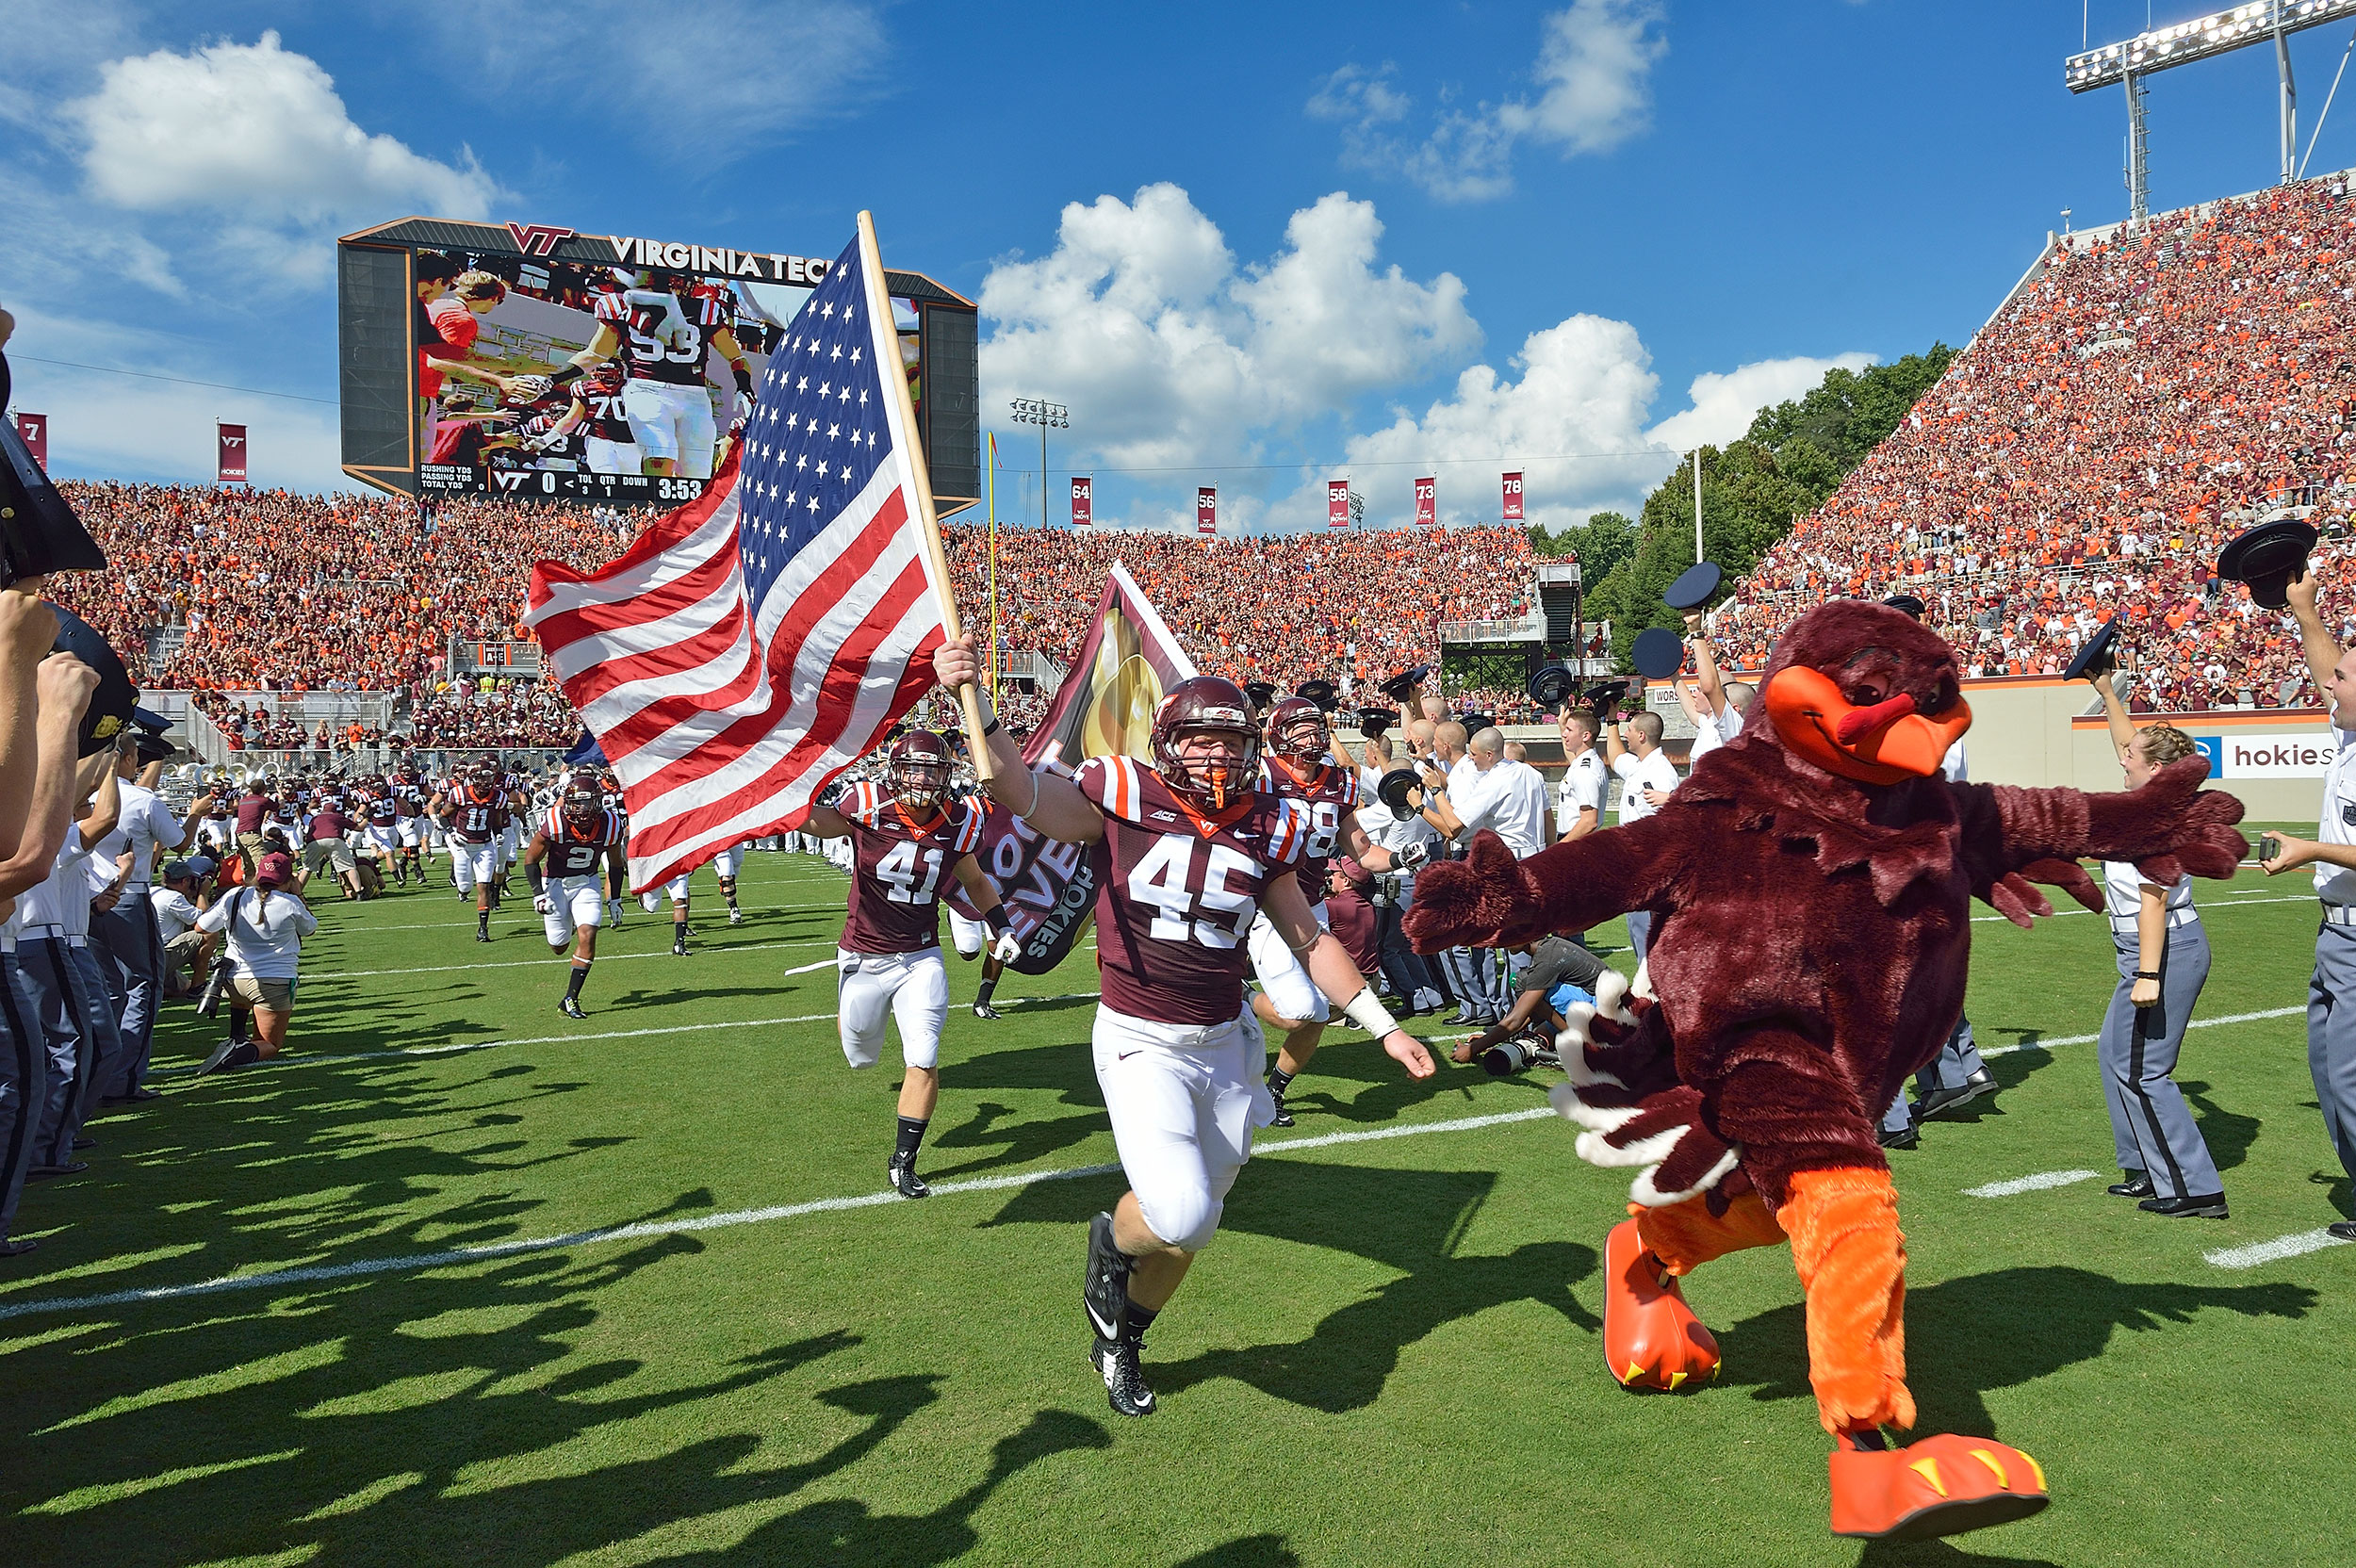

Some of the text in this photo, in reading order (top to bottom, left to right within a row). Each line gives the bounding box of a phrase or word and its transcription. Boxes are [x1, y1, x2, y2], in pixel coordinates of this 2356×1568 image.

[505, 221, 575, 257] VT
[609, 235, 834, 284] VIRGINIA TEC
[25, 423, 39, 441] 7
[221, 435, 245, 448] VT
[421, 465, 472, 475] RUSHING YDS
[421, 472, 472, 482] PASSING YDS
[493, 471, 532, 491] VT
[542, 472, 556, 494] 0
[578, 474, 648, 486] TOL QTR DOWN
[659, 479, 702, 500] 3:53
[1503, 480, 1523, 495] 78
[581, 485, 612, 497] 3 1
[1072, 485, 1090, 499] 64
[1329, 488, 1348, 502] 58
[1415, 485, 1434, 499] 73
[1198, 495, 1215, 509] 56
[2235, 744, 2340, 766] hokies
[370, 798, 396, 819] 39
[1149, 809, 1178, 823] ACC
[466, 808, 489, 831] 11
[566, 846, 596, 869] 2
[875, 839, 944, 905] 41
[1127, 832, 1269, 950] 45
[1027, 865, 1096, 958] HOKIES
